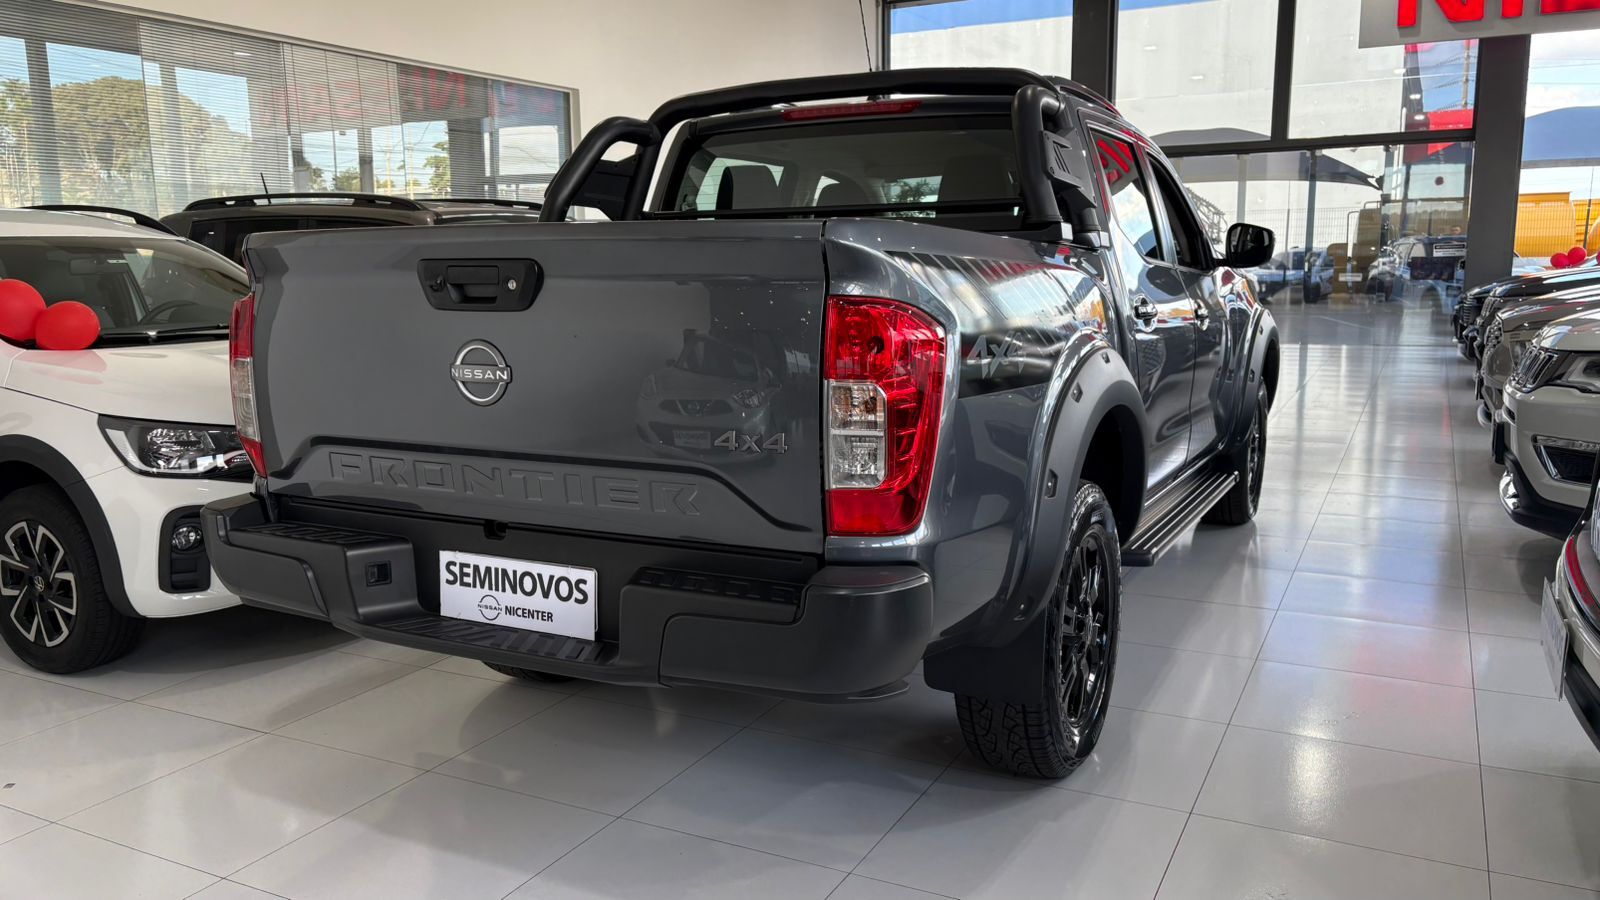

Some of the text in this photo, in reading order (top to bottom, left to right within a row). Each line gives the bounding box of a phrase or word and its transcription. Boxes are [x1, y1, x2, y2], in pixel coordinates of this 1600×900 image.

[451, 367, 508, 380] NISSAN
[329, 451, 700, 515] FRONTIER
[445, 561, 588, 604] SEMINOVOS
[477, 603, 554, 622] NISSAN NICENTER
